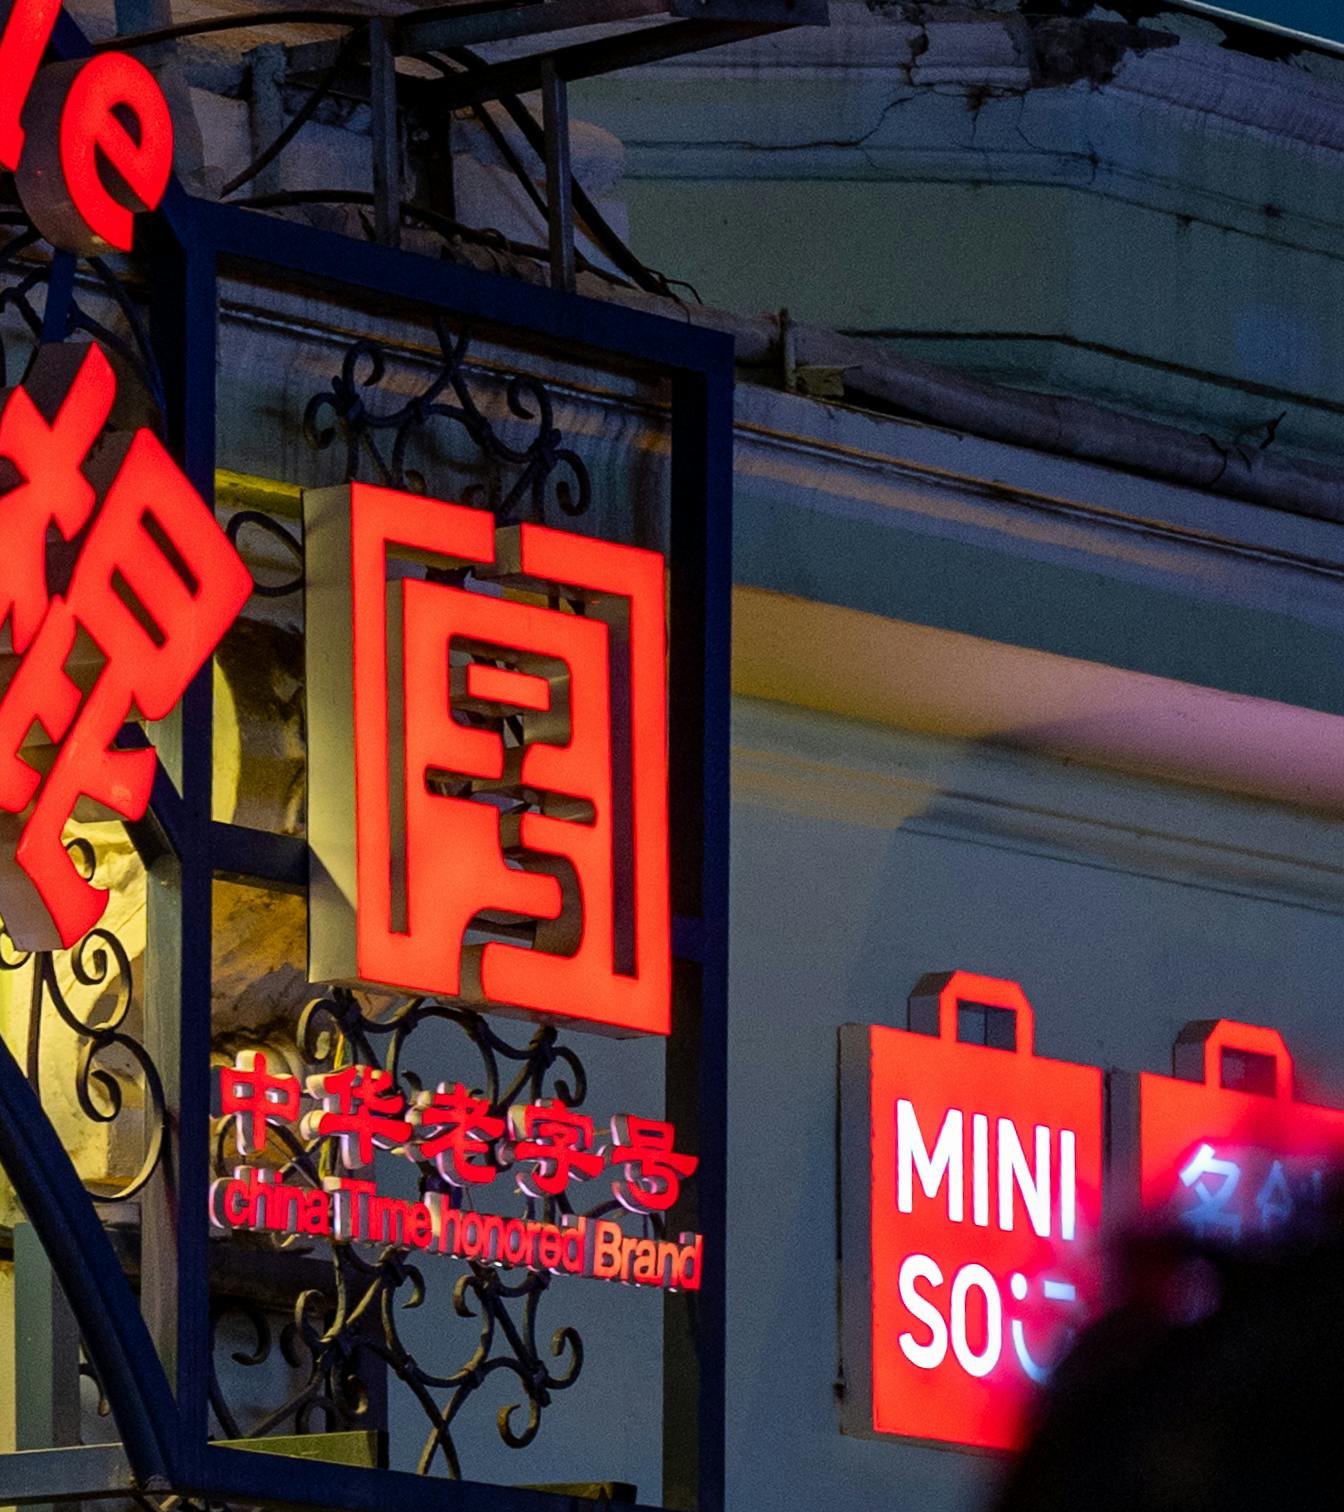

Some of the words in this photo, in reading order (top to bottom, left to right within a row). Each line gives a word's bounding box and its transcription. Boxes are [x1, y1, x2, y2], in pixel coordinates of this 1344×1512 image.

[218, 1051, 700, 1213] 中华老字号
[896, 1098, 1076, 1241] MINI
[338, 1179, 434, 1249] Time
[438, 1194, 587, 1274] honored
[593, 1218, 705, 1291] Brand
